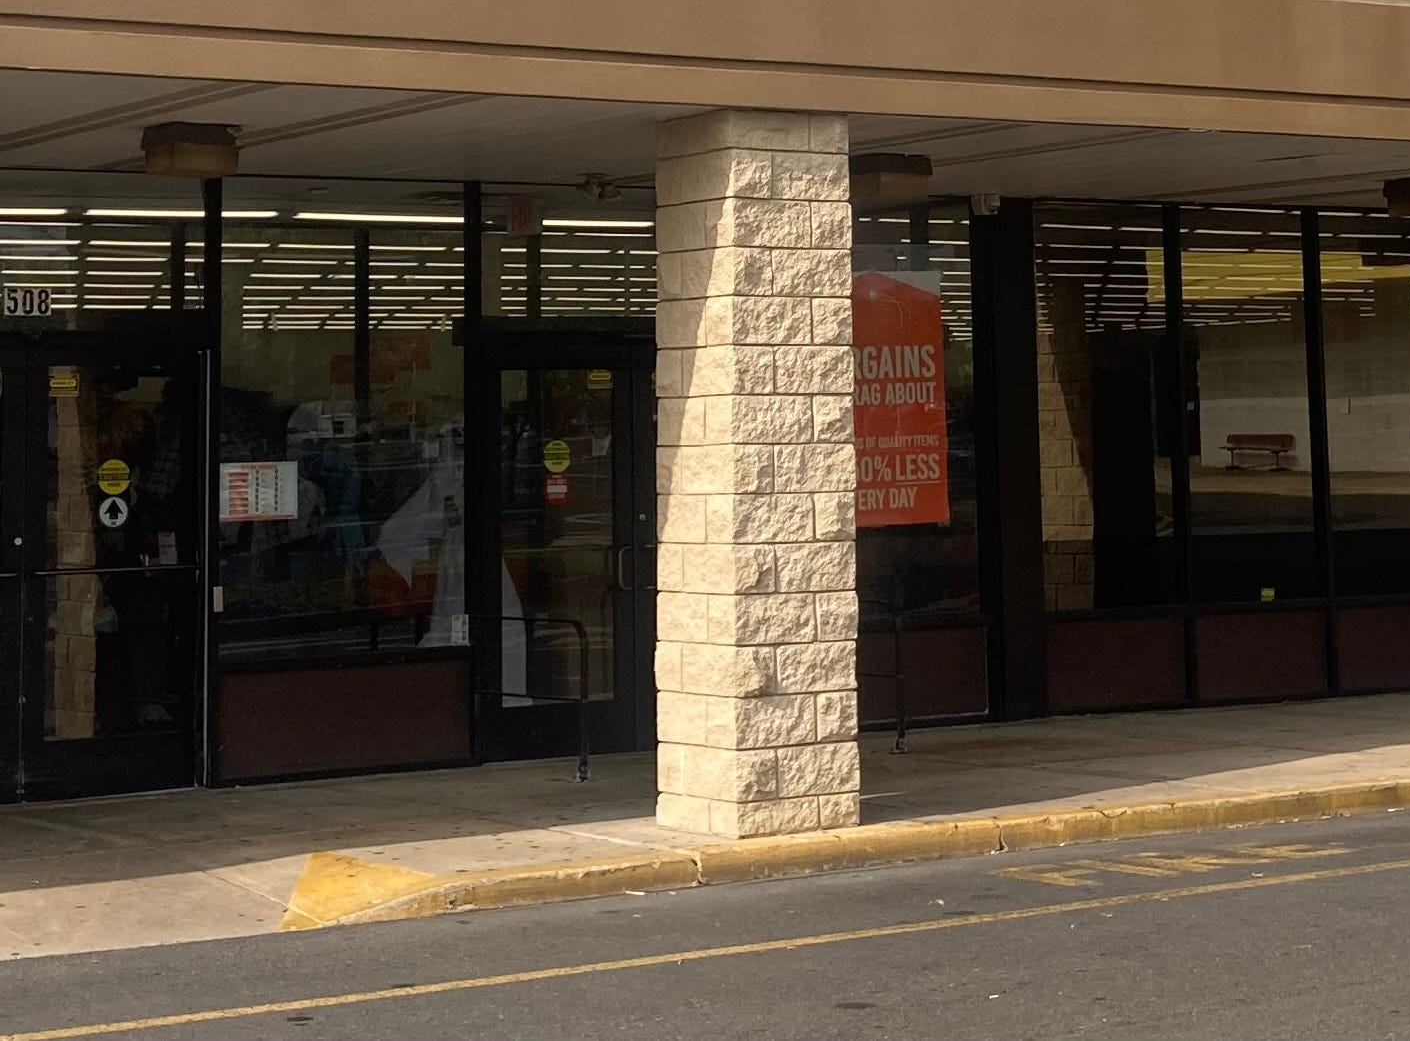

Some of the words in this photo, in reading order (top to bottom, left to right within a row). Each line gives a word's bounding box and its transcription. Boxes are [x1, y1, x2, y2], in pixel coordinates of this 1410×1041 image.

[6, 288, 50, 315] 508
[851, 344, 936, 380] RGAINS
[853, 382, 881, 407] RAG
[885, 381, 937, 405] ABOUT
[913, 434, 940, 448] ITEMS
[895, 453, 941, 483] LESS
[858, 489, 887, 511] ERY
[889, 486, 918, 509] DAY
